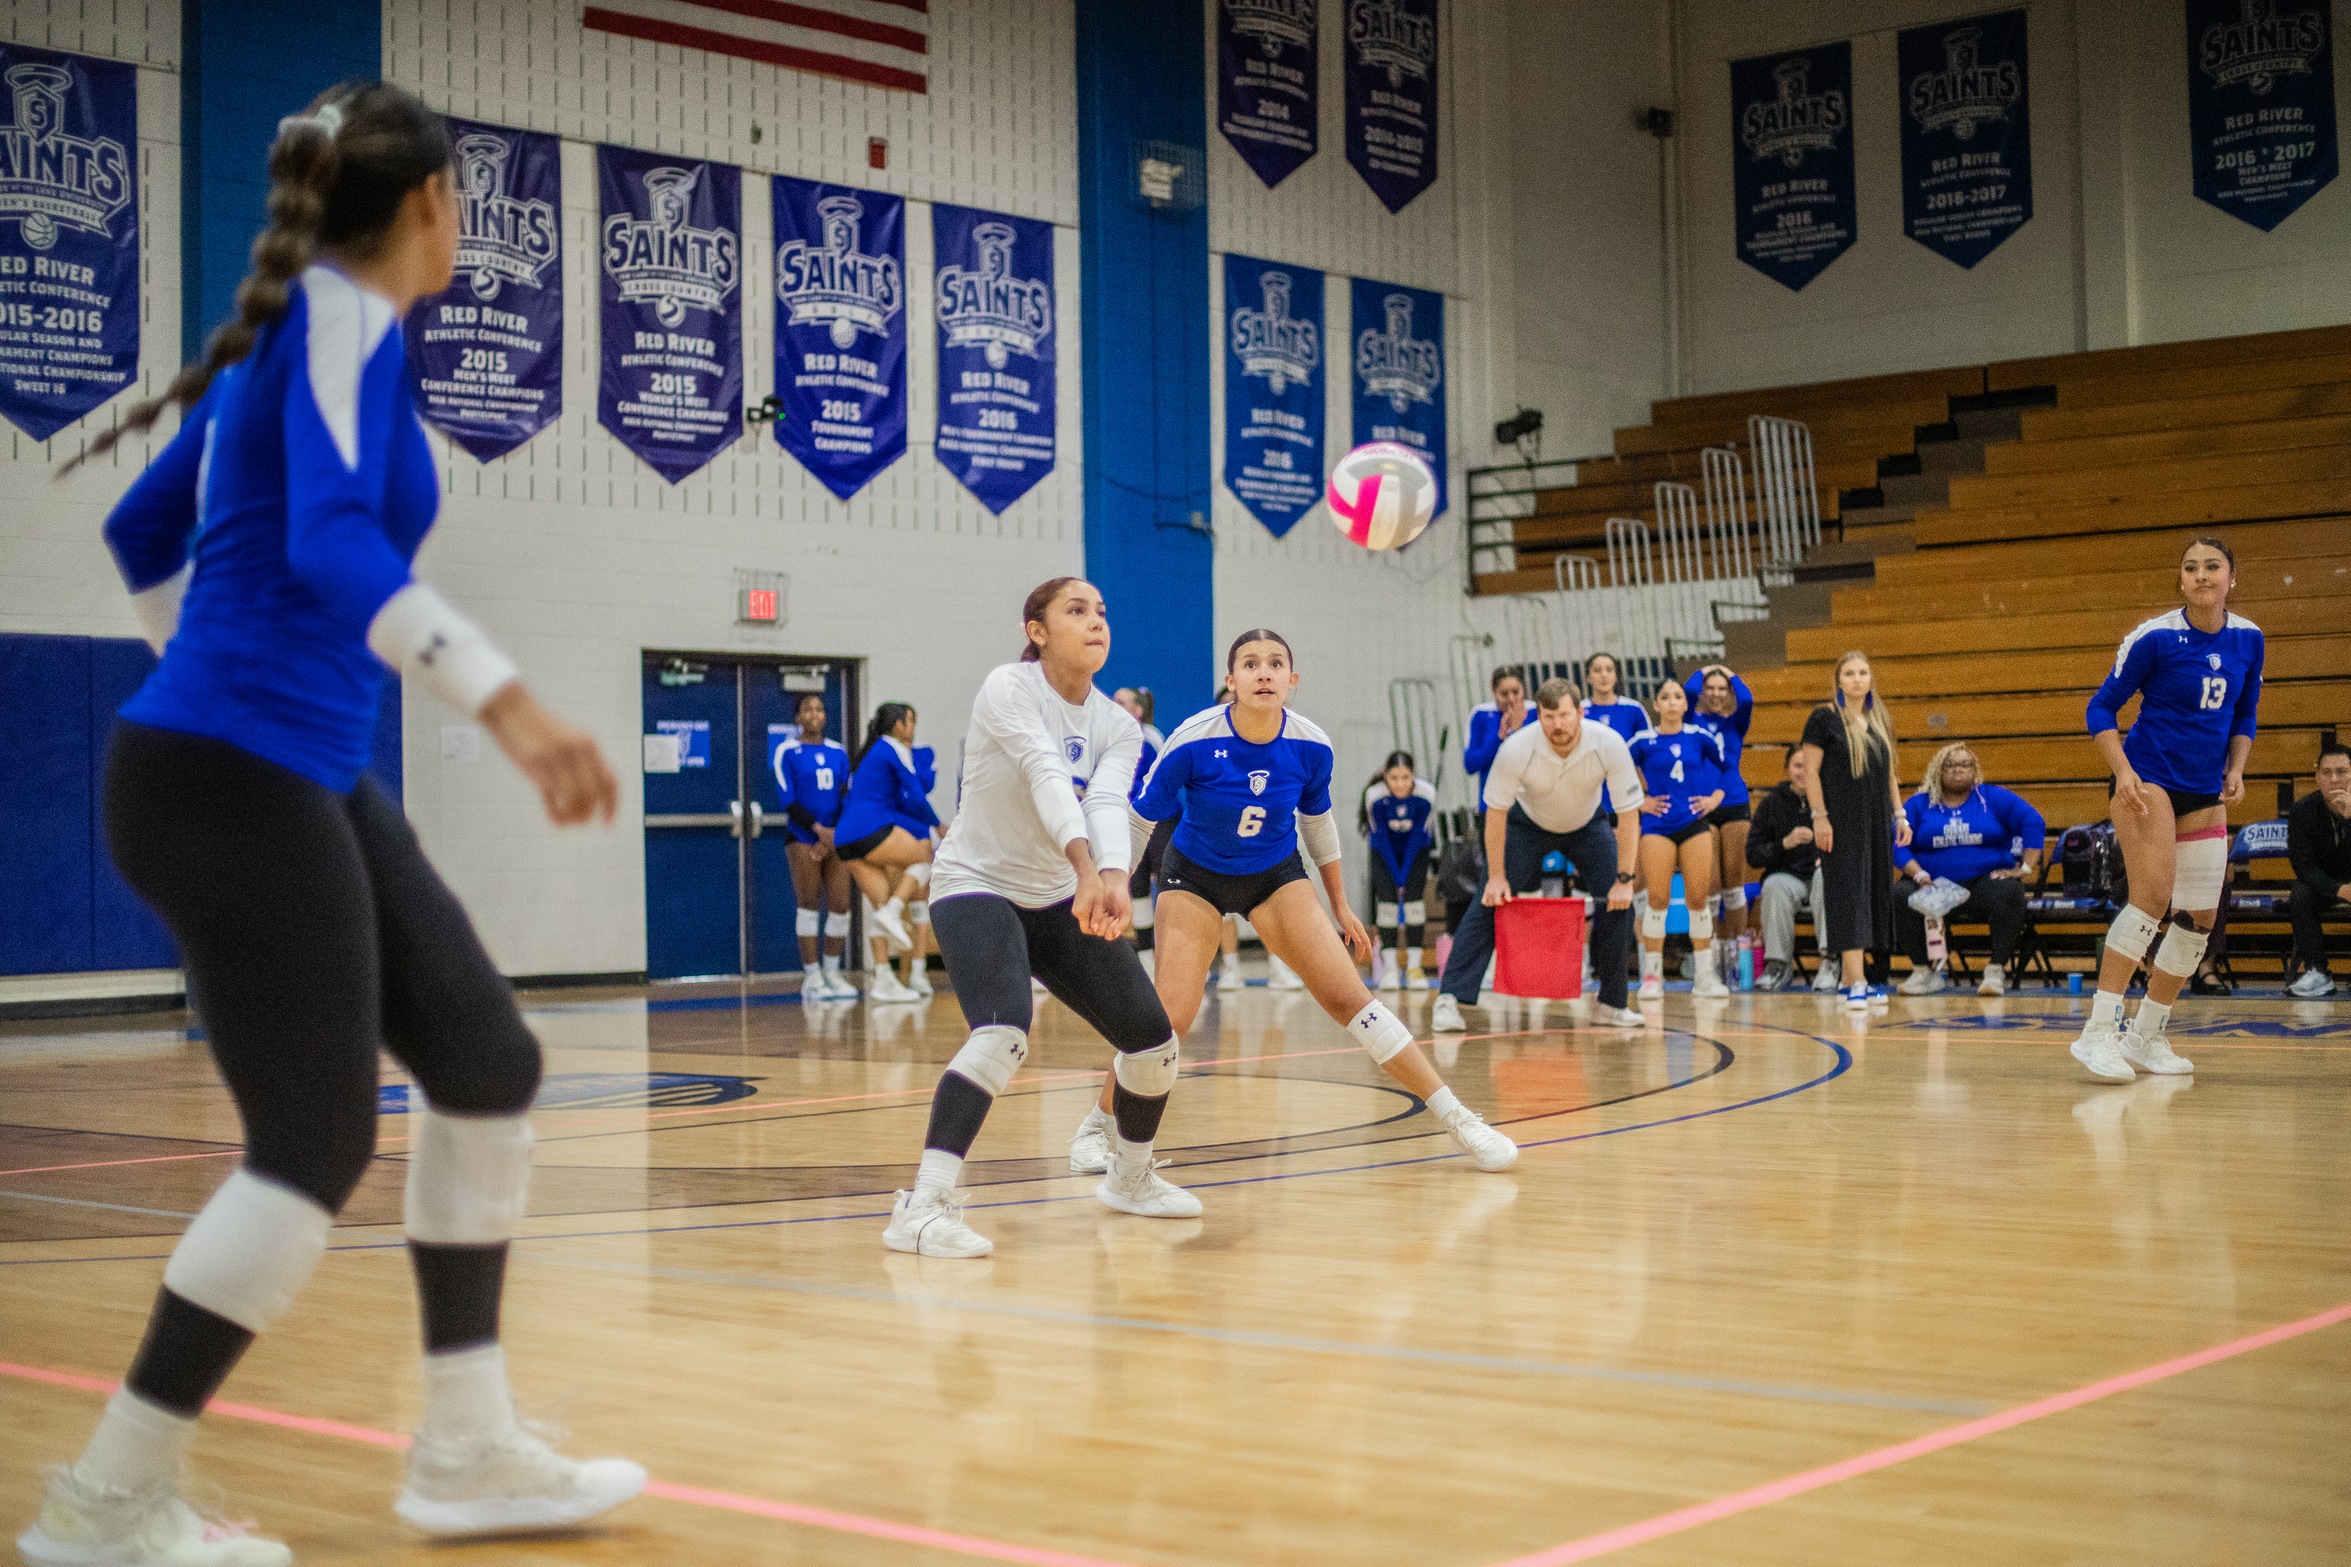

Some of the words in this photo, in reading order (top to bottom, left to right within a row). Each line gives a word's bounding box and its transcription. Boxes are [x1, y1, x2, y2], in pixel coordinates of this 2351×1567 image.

[2202, 14, 2322, 70] SAINTS
[1911, 61, 2020, 112] SAINTS
[1743, 91, 1846, 136] SAINTS
[2225, 112, 2254, 130] RED
[2259, 107, 2304, 122] RIVER
[1931, 156, 1958, 175] RED
[1961, 151, 2001, 168] RIVER
[2215, 150, 2257, 171] 2016
[2273, 141, 2316, 161] 2017
[456, 195, 557, 263] INTS
[604, 214, 738, 287] SAINTS
[0, 256, 28, 275] ED
[34, 256, 95, 286] RIVER
[779, 241, 901, 309] SAINTS
[0, 280, 27, 294] ETIC
[28, 281, 111, 309] CONFERENCE
[938, 266, 1050, 331] SAINTS
[0, 301, 103, 333] 15-2016
[440, 305, 478, 325] RED
[481, 305, 528, 334] RIVER
[31, 332, 77, 348] SEASON
[78, 337, 103, 350] AND
[424, 328, 476, 344] ATHLETIC
[477, 328, 542, 354] CONFERENCE
[634, 331, 665, 350] RED
[667, 333, 716, 357] RIVER
[1233, 309, 1317, 361] SAINTS
[47, 349, 114, 367] CHAMPIONS
[461, 347, 508, 373] 2015
[664, 354, 724, 378] CONFERENCE
[804, 353, 837, 372] RED
[838, 354, 878, 379] RIVER
[1358, 330, 1440, 383] SAINTS
[14, 379, 50, 394] SWEET
[42, 365, 127, 384] CHAMPIONSHIP
[650, 372, 697, 396] 2015
[961, 371, 992, 388] RED
[993, 372, 1030, 396] RIVER
[421, 378, 486, 396] CONFERENCE
[487, 383, 545, 402] CHAMPIONS
[821, 399, 861, 422] 2015
[750, 592, 776, 618] EXIT
[2200, 676, 2227, 709] 13
[1670, 759, 1685, 784] 4
[1237, 805, 1267, 838] 6
[2246, 825, 2290, 843] SAINT
